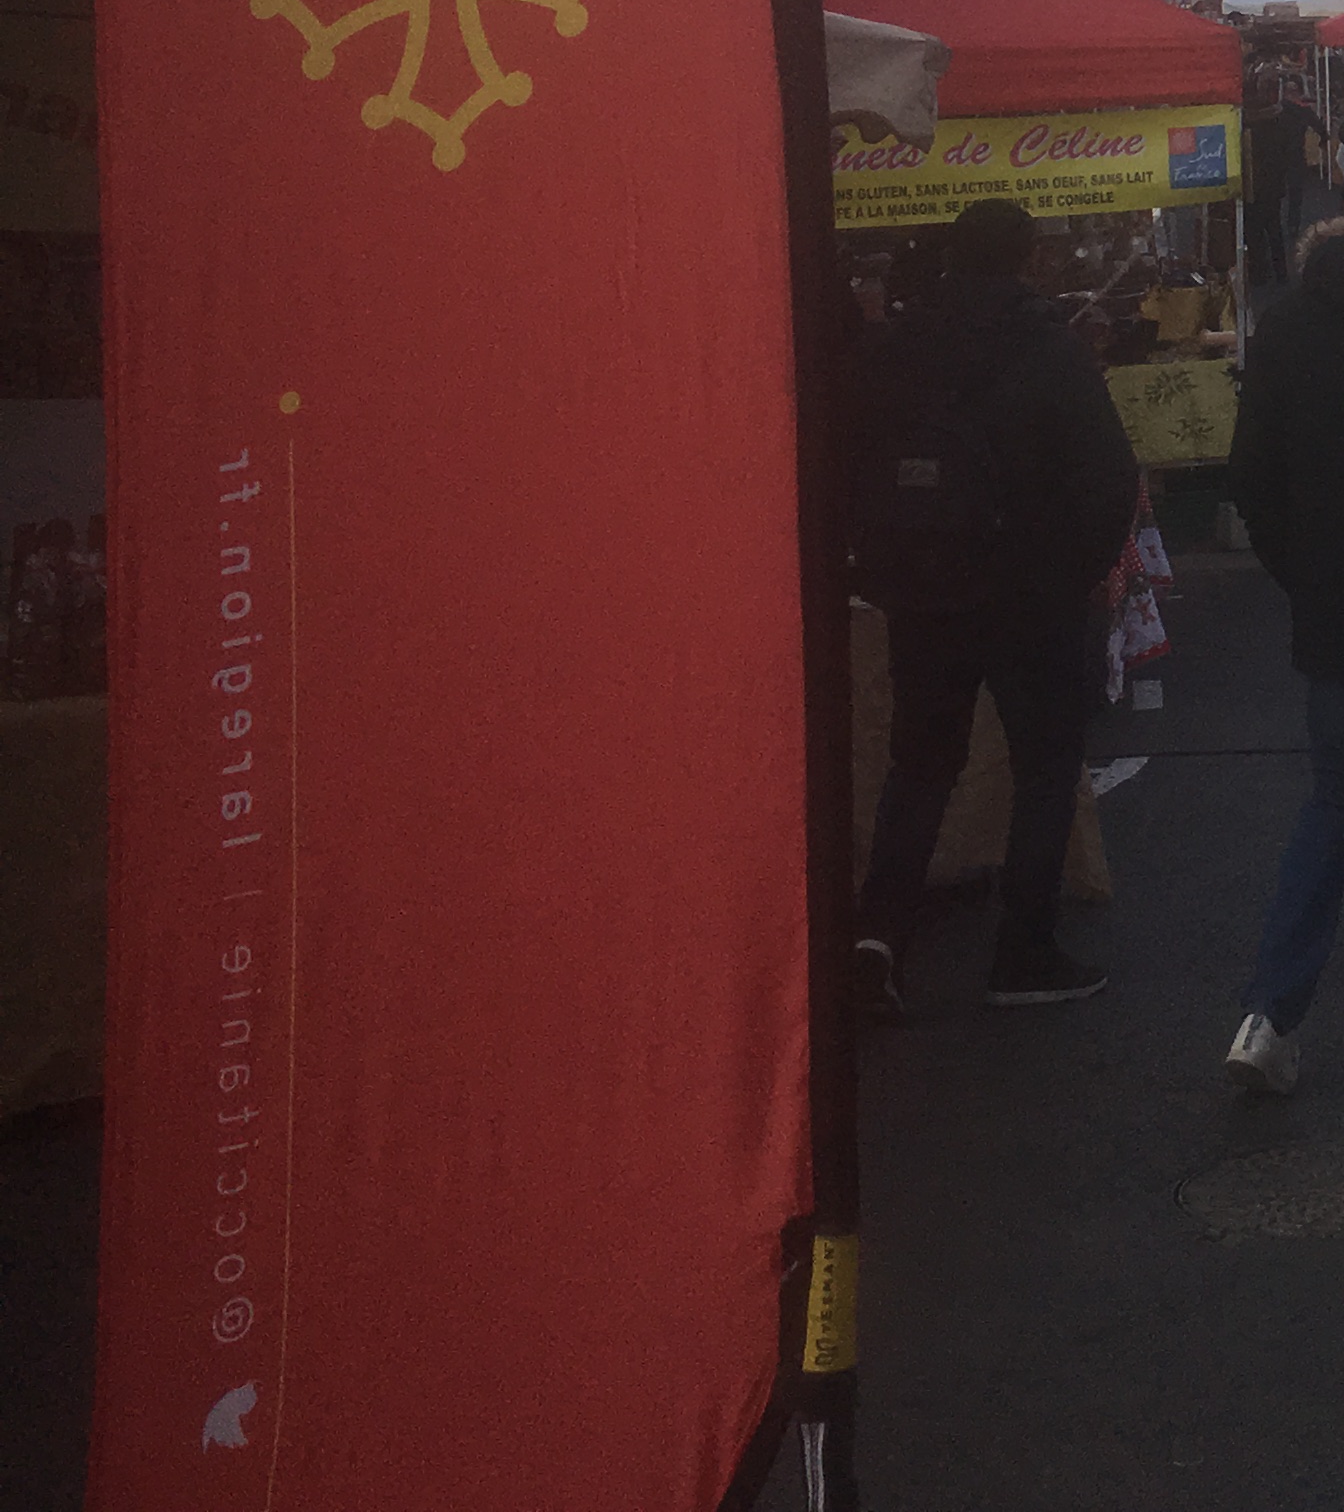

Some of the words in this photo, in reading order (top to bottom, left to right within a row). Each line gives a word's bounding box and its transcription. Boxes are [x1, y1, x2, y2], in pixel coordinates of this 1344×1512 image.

[942, 131, 993, 166] de
[1009, 124, 1147, 169] Céline
[857, 185, 912, 200] GLUTEN,
[915, 183, 949, 197] SANS
[1016, 178, 1049, 192] SANS
[1053, 176, 1087, 189] OEUF,
[1091, 173, 1124, 186] SANS
[1127, 171, 1154, 184] LAIT
[868, 205, 884, 218] LA
[944, 200, 960, 214] SE
[1038, 194, 1054, 208] SE
